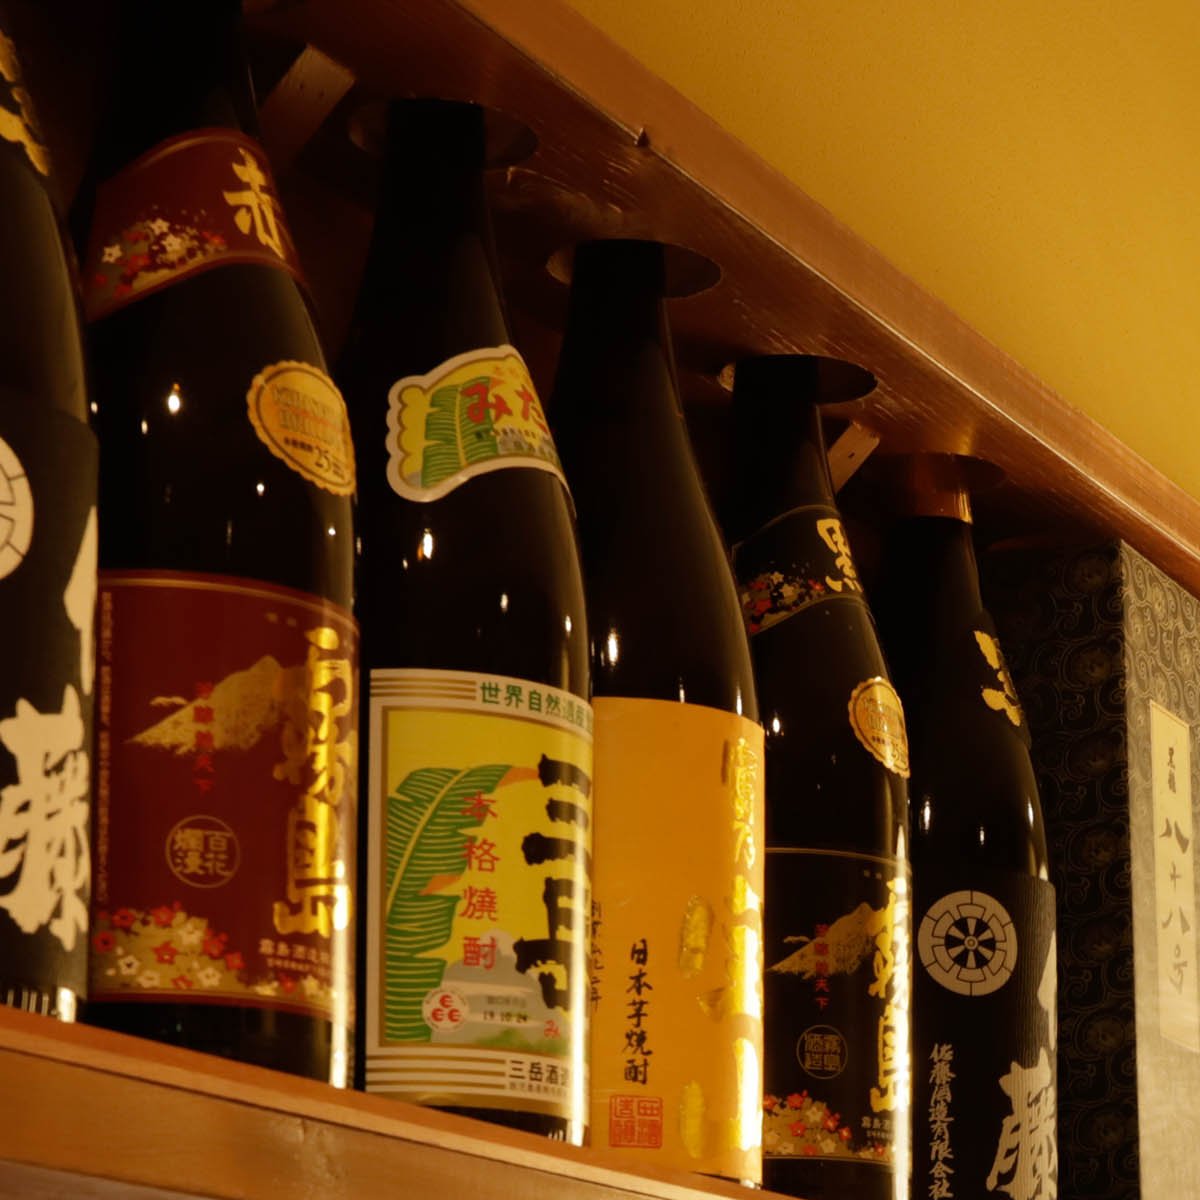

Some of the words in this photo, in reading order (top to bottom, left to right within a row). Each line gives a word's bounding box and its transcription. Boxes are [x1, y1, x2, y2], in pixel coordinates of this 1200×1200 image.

[622, 937, 653, 1085] 日本芋焼酎
